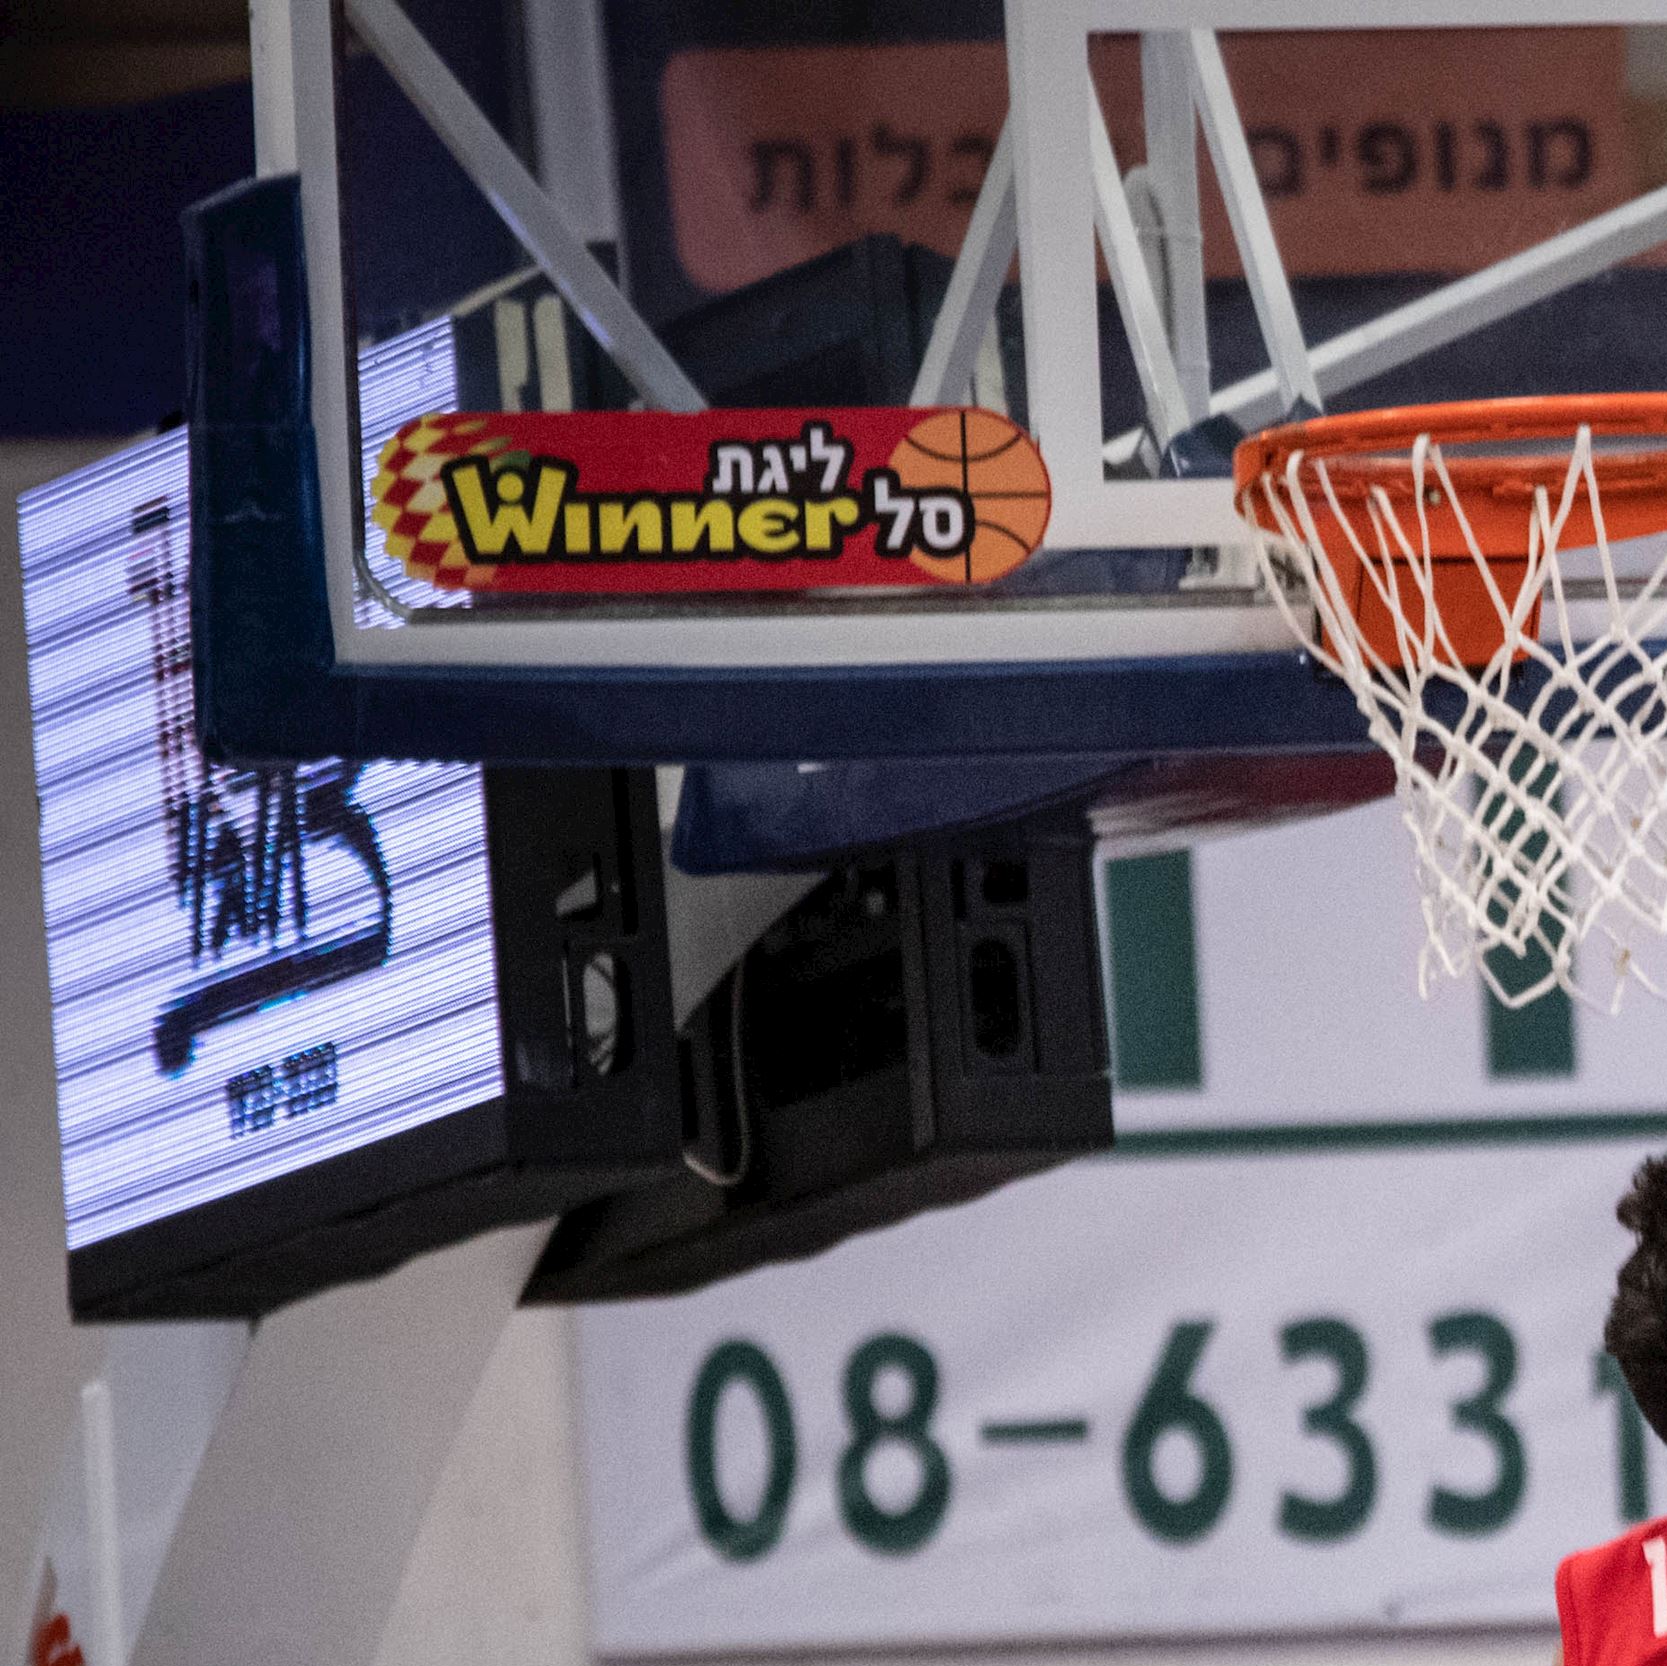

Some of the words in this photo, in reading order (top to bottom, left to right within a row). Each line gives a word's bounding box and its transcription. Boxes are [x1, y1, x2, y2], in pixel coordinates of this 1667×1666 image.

[1245, 115, 1594, 196] מנופים
[711, 429, 846, 494] ליגת
[450, 465, 860, 555] Winner
[874, 478, 965, 550] סל
